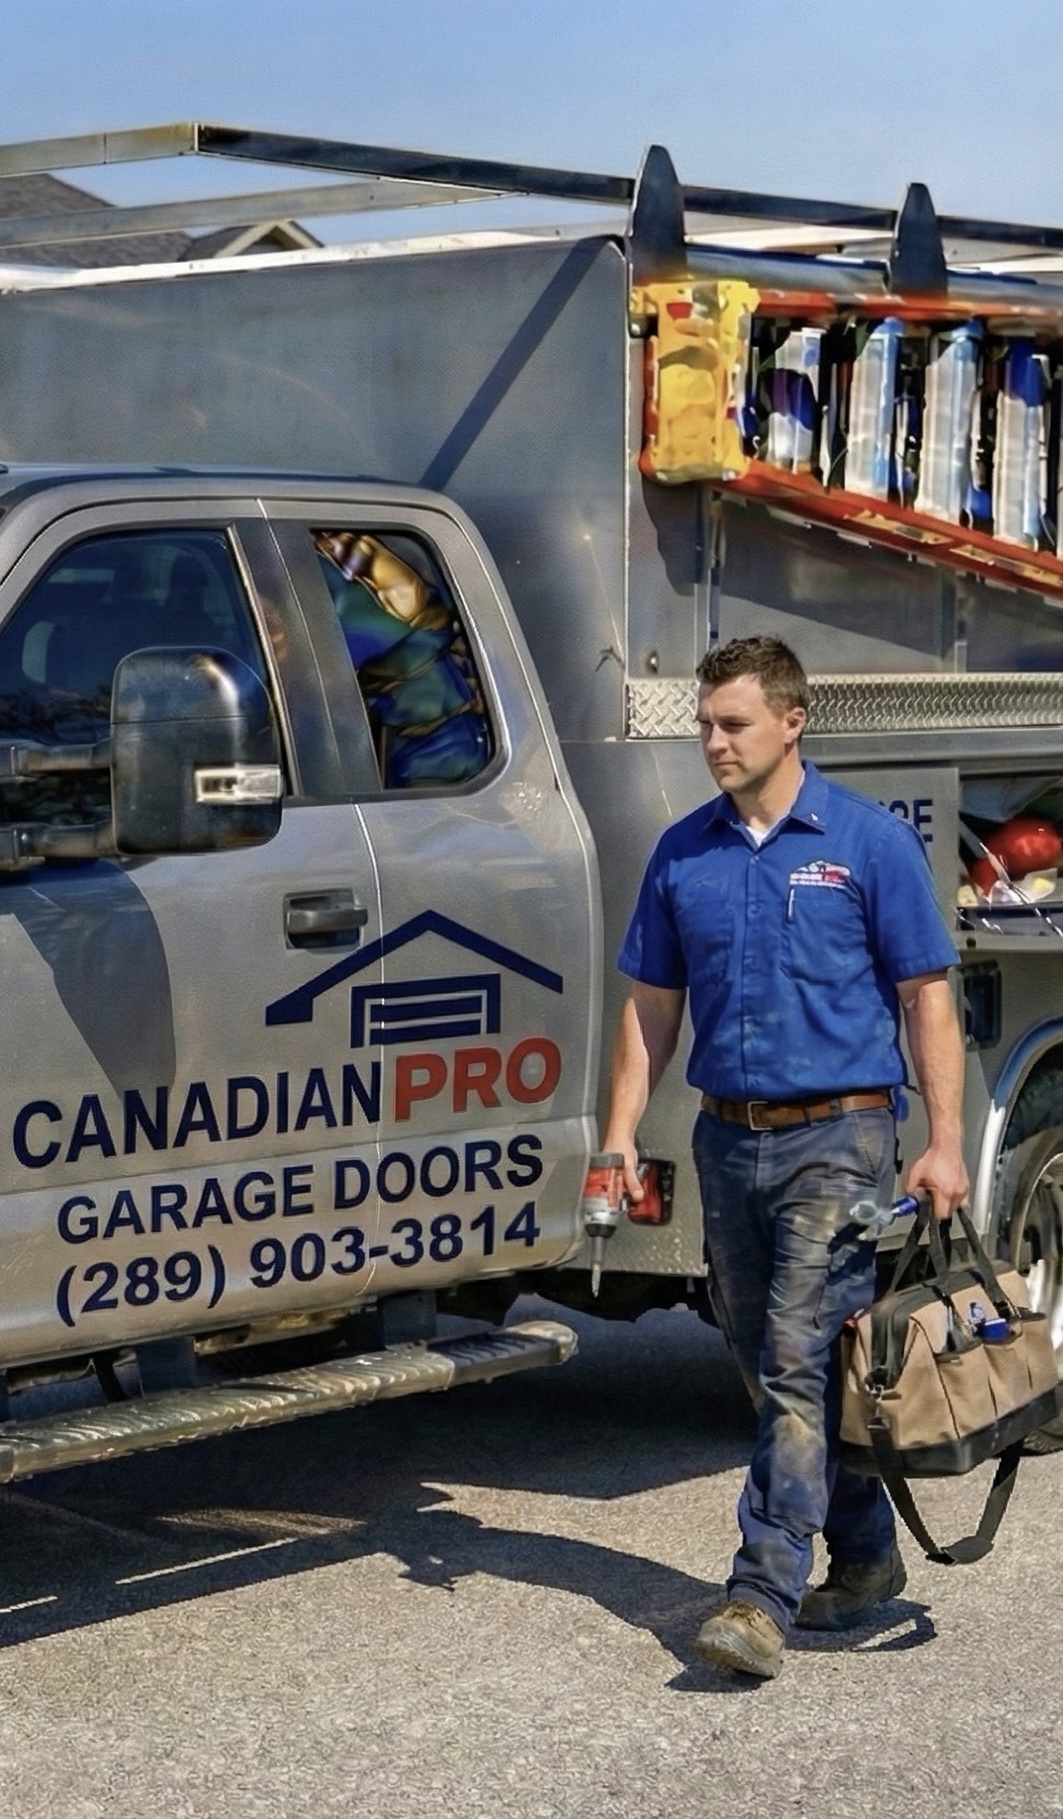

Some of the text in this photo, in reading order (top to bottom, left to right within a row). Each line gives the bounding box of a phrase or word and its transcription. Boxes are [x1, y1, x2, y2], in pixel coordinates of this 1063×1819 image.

[57, 1134, 544, 1245] GARAGE DOORS
[56, 1201, 541, 1328] (289) 903-3814
